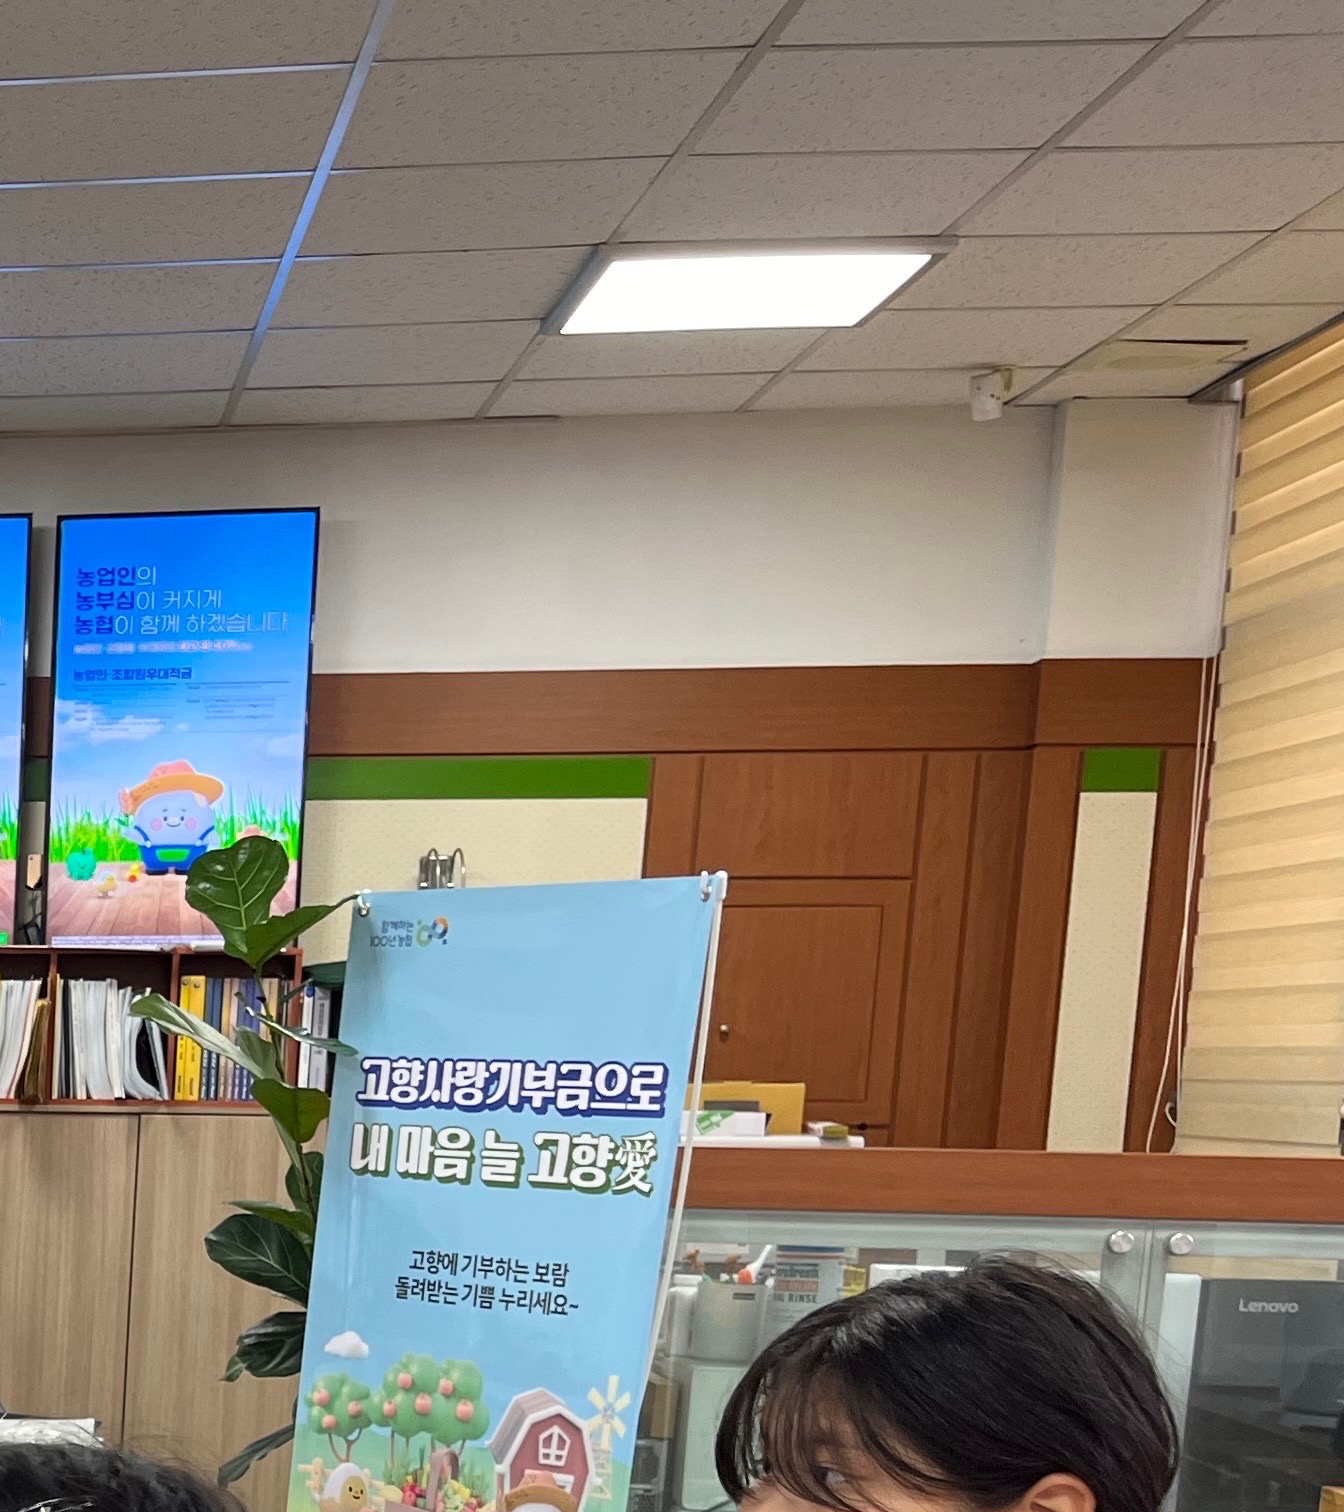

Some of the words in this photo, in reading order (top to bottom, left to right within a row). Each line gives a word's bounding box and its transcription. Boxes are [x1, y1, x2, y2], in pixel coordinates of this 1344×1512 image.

[77, 566, 156, 586] 농업인의
[76, 590, 155, 611] 농부심이
[163, 589, 222, 609] 커지게
[75, 615, 134, 635] 농협이
[140, 614, 180, 634] 함께
[186, 611, 288, 633] 하겠습니다
[357, 1058, 666, 1114] 고향사랑기부금으로
[351, 1124, 387, 1174] 내
[397, 1125, 473, 1182] 마음
[480, 1131, 521, 1185] 늘
[529, 1131, 658, 1197] 고향愛
[409, 1250, 459, 1276] 고향에
[461, 1255, 530, 1282] 기부하는
[532, 1262, 570, 1288] 보람
[395, 1278, 459, 1306] 돌려받는
[462, 1283, 494, 1309] 기쁨
[498, 1290, 579, 1318] 누리세요~
[1238, 1298, 1298, 1313] Lenovo
